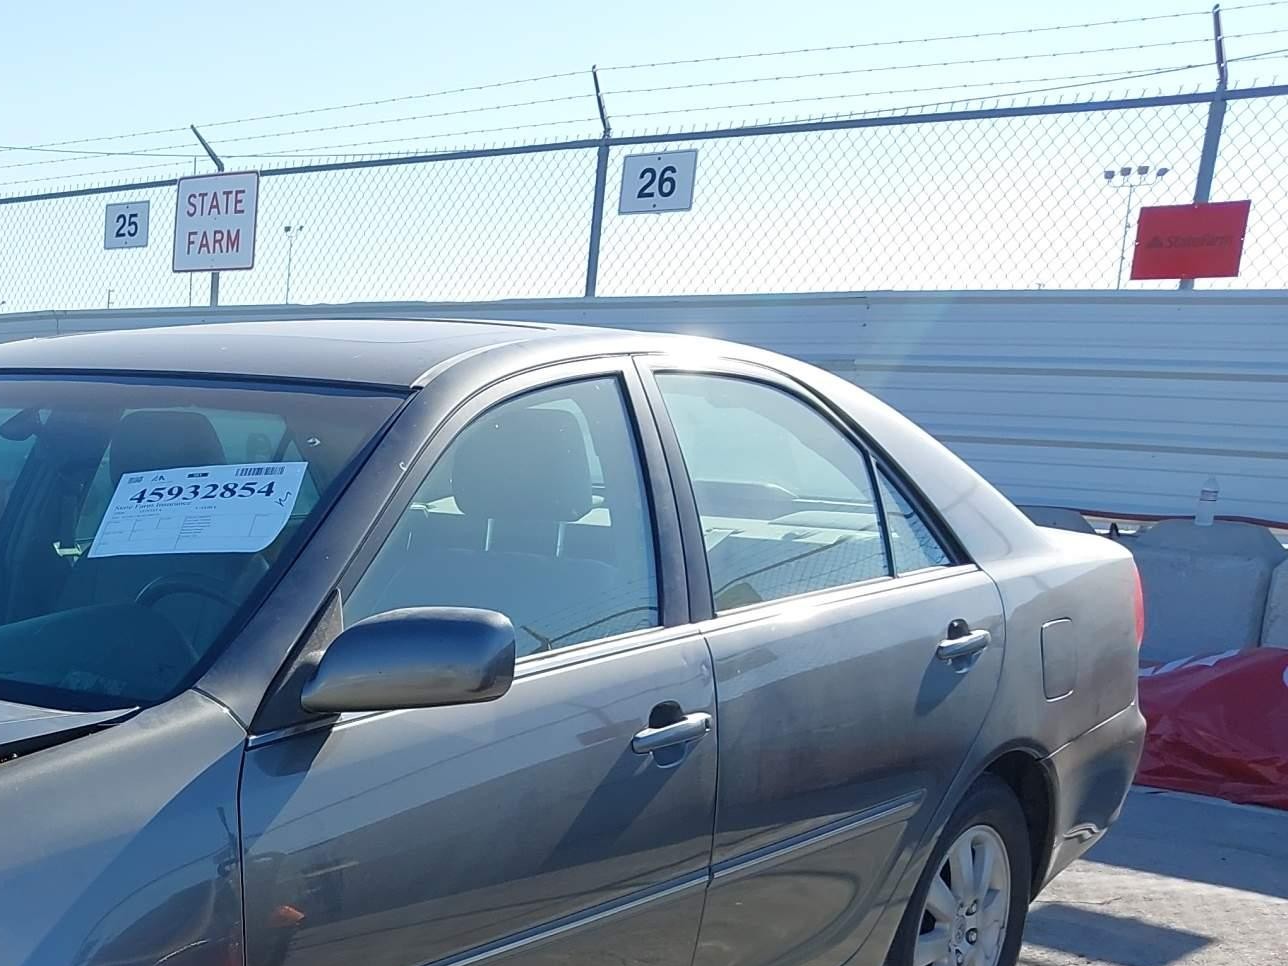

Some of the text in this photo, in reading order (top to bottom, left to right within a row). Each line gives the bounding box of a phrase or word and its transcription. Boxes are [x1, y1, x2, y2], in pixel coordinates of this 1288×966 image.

[637, 166, 677, 199] 26
[186, 190, 246, 218] STATE
[115, 213, 138, 238] 25
[186, 228, 240, 255] FARM
[129, 481, 275, 503] 45932854
